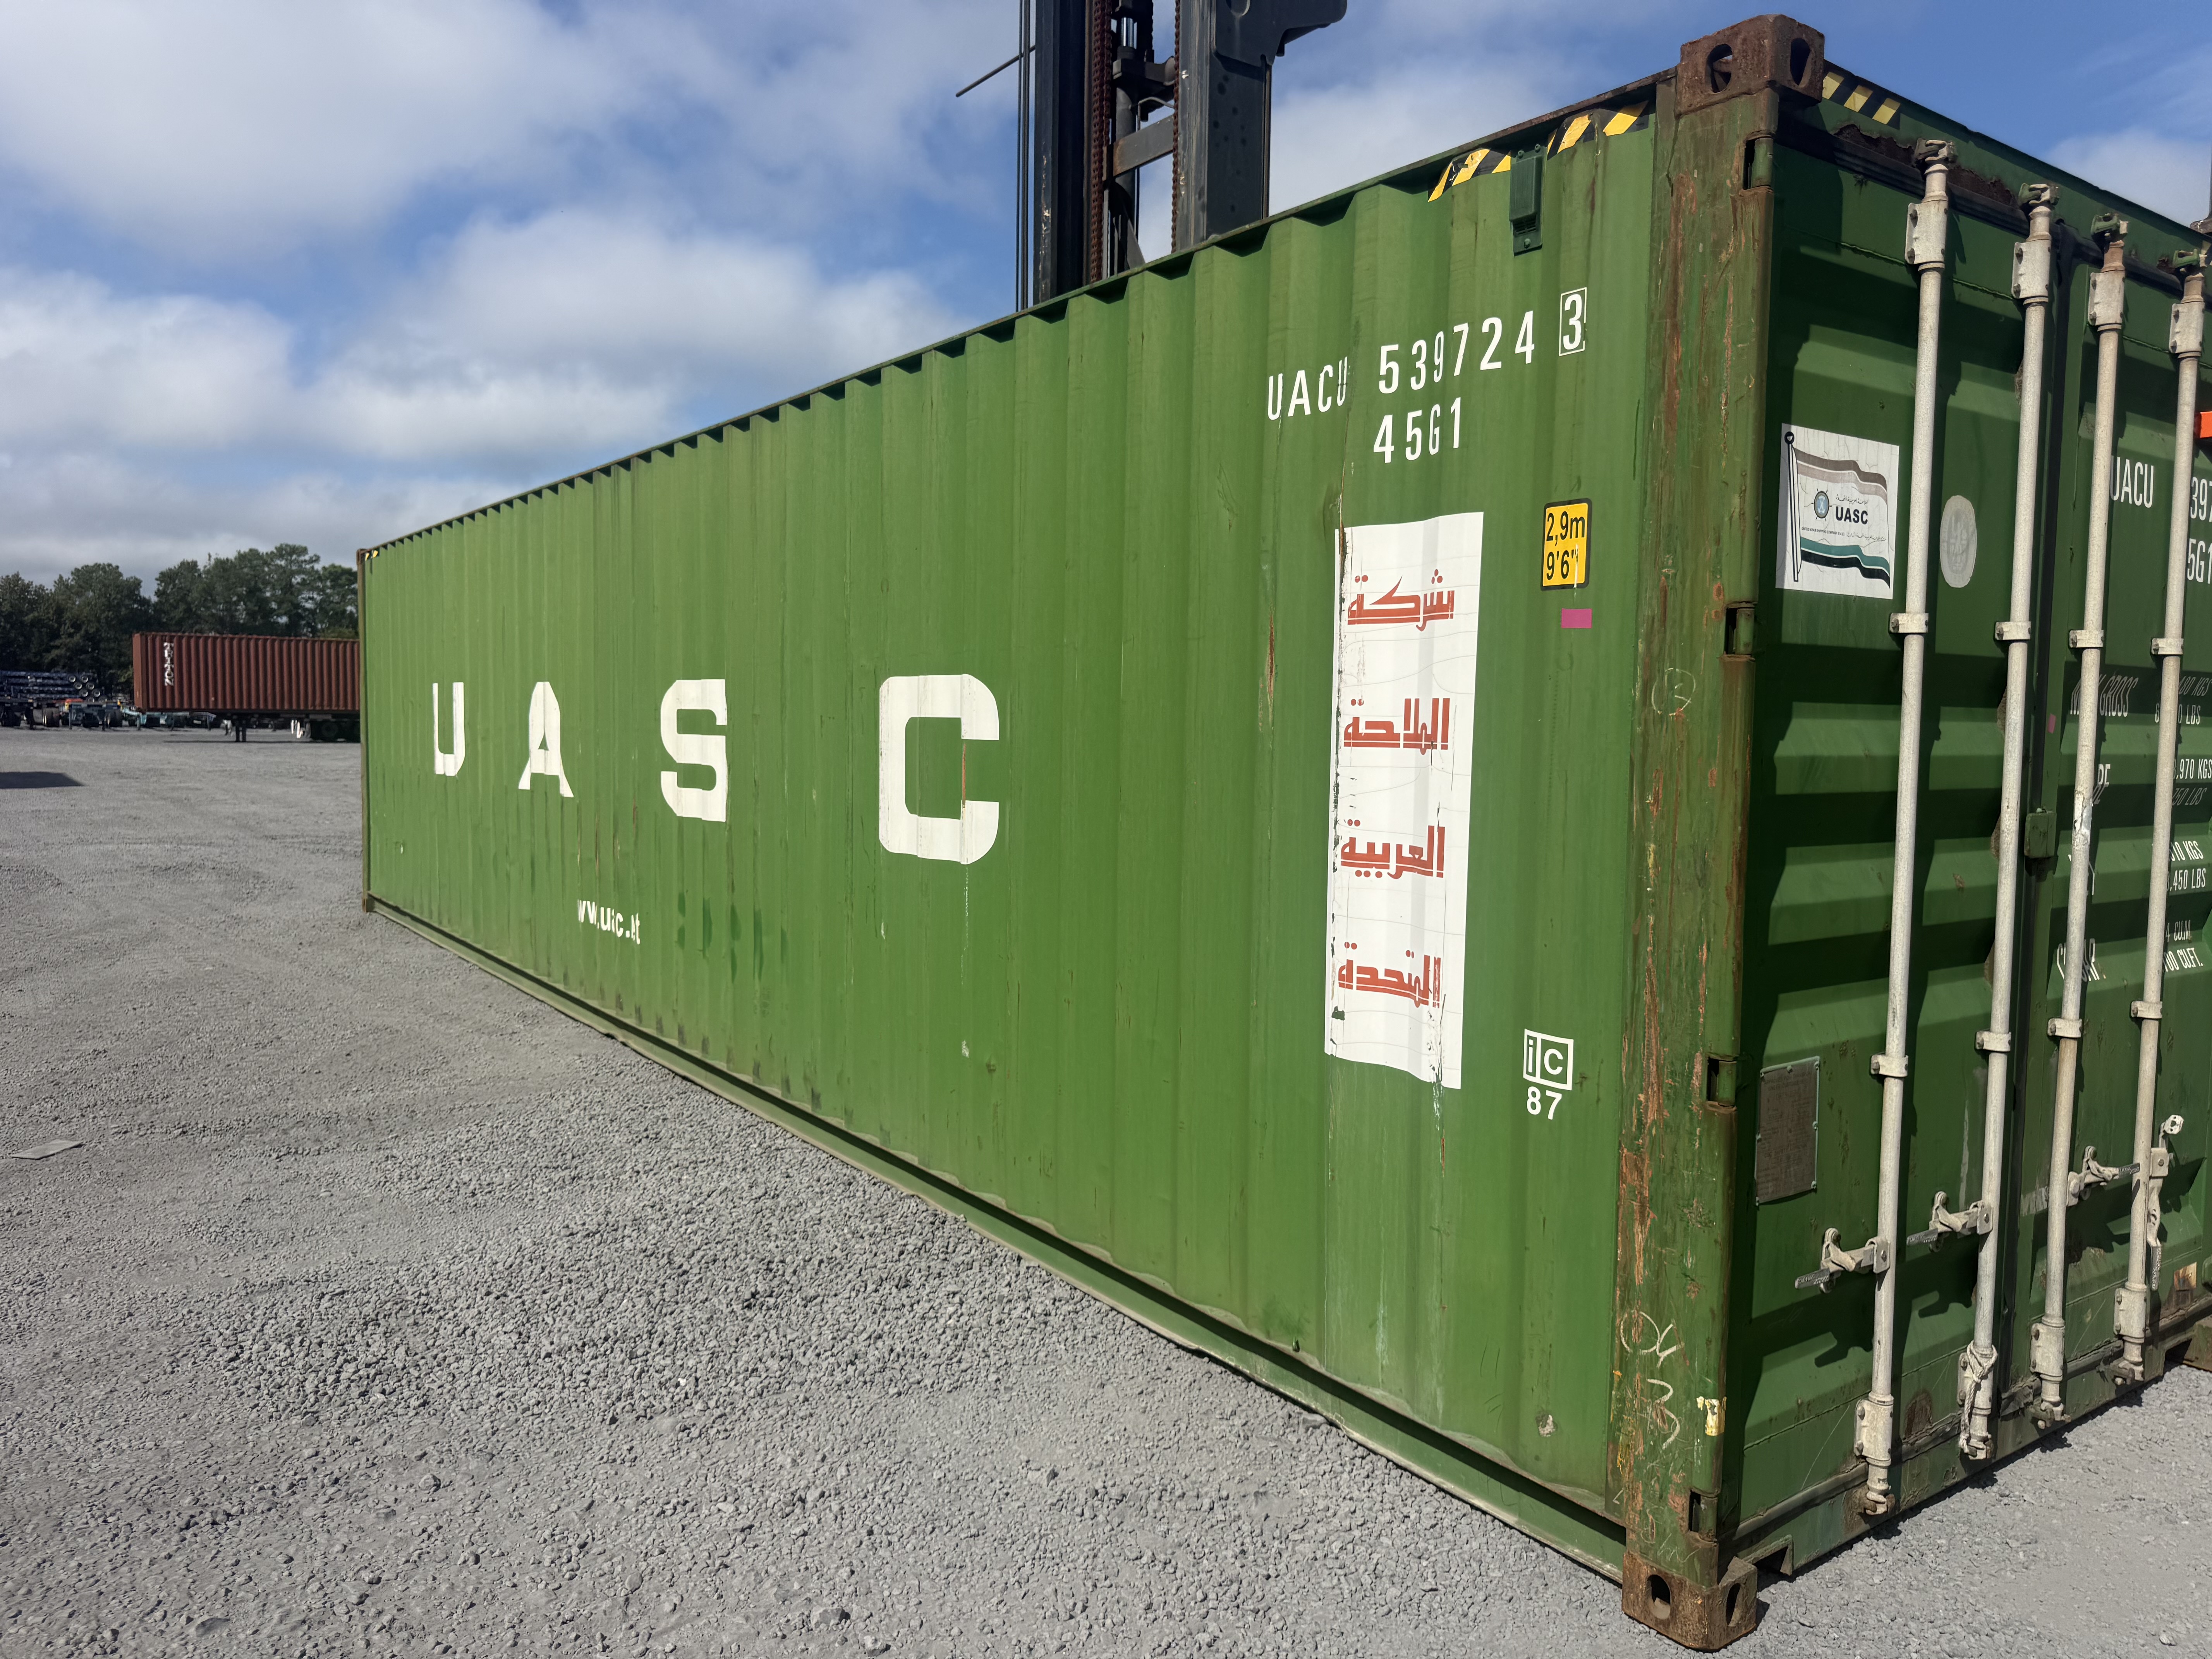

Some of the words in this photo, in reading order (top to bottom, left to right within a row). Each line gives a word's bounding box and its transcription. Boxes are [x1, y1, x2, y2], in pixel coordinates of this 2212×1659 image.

[1268, 356, 1348, 420] UACU
[1379, 311, 1535, 394] 539724
[1563, 294, 1582, 350] 3
[1373, 397, 1462, 463] 45G1
[2110, 455, 2154, 508] UACU
[1546, 511, 1585, 546] 2,9m
[1836, 506, 1868, 525] UASC
[2187, 538, 2212, 584] 5G1
[1347, 568, 1455, 632] شركة
[2099, 675, 2139, 717] GROSS
[2186, 704, 2201, 725] LBS
[1344, 697, 1450, 756] الملاحة
[432, 674, 1000, 865] UASC
[2092, 764, 2111, 805] RE
[2198, 759, 2212, 779] KGS
[2185, 787, 2207, 805] LBS
[1341, 819, 1445, 879] العربية
[2183, 840, 2203, 860] KGS
[2191, 868, 2206, 889] LBS
[1338, 941, 1441, 1008] المتحدة
[1527, 1086, 1562, 1120] 87
